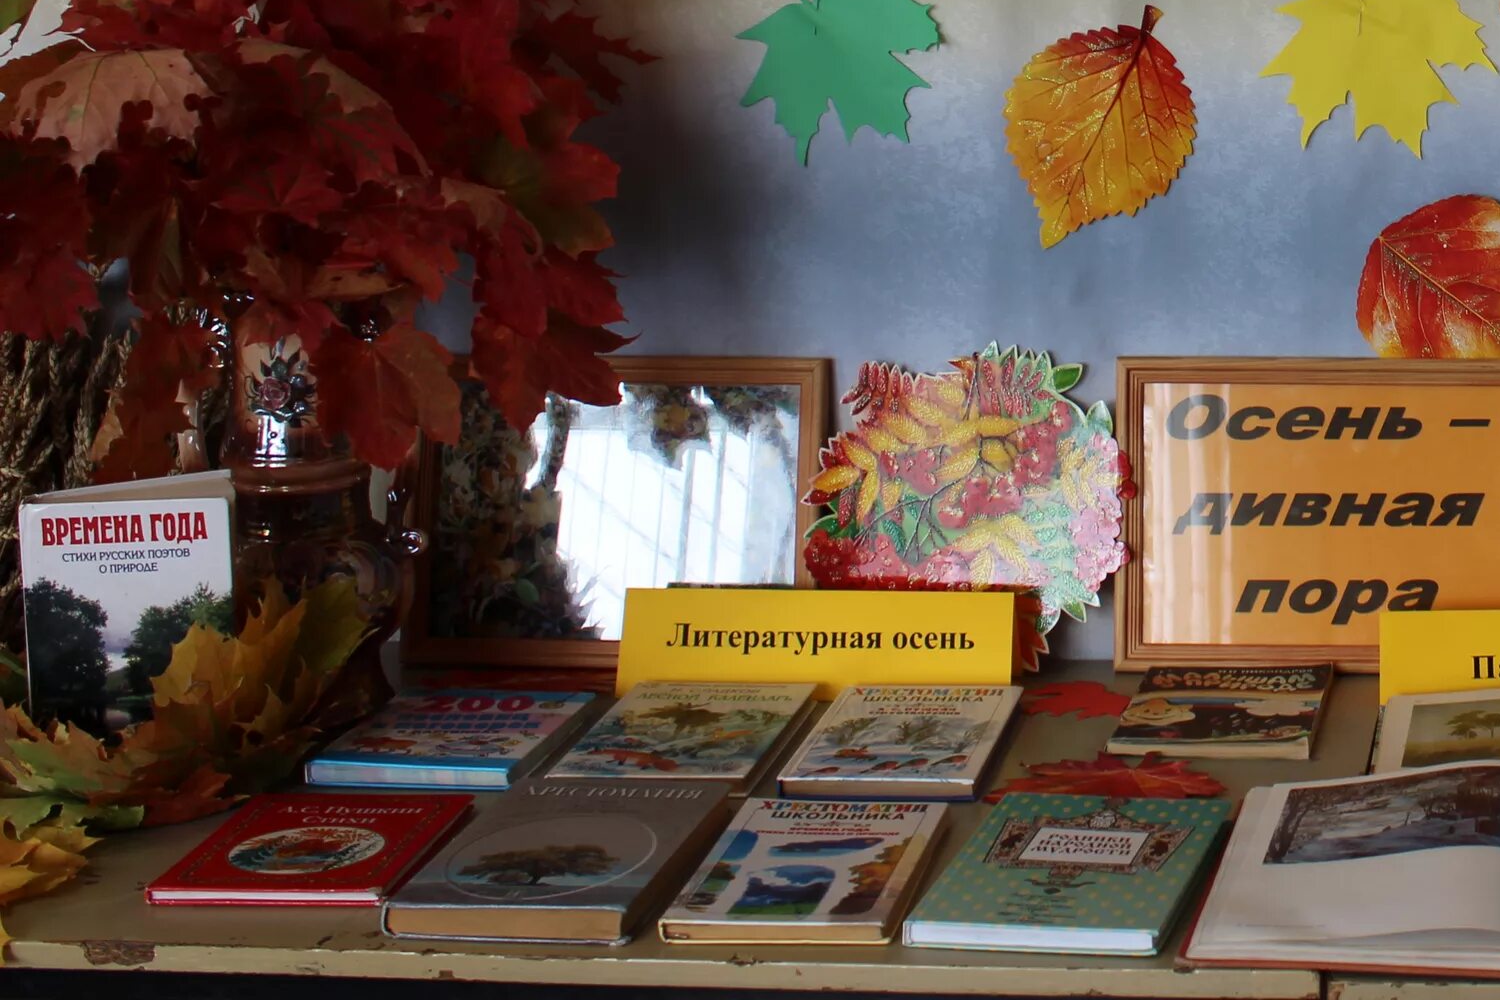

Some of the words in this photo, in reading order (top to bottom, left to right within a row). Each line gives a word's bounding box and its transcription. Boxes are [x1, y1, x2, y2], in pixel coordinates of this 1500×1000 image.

[1165, 393, 1423, 442] Осень
[1171, 492, 1486, 536] дивная
[40, 514, 146, 547] ВРЕМЕНА
[149, 511, 208, 544] ГОДА
[61, 551, 98, 563] СТИХИ
[99, 549, 146, 562] РУССКИХ
[147, 547, 191, 560] ПОЭТОВ
[98, 564, 108, 574] О
[109, 562, 159, 574] ПРИРОДЕ
[1234, 578, 1440, 626] пора
[665, 622, 882, 656] Литературная
[892, 631, 976, 651] осень
[412, 695, 536, 713] 200
[760, 799, 929, 813] ХРЕСТОМАТИЯ
[770, 811, 905, 821] ШКОЛЬНИКА
